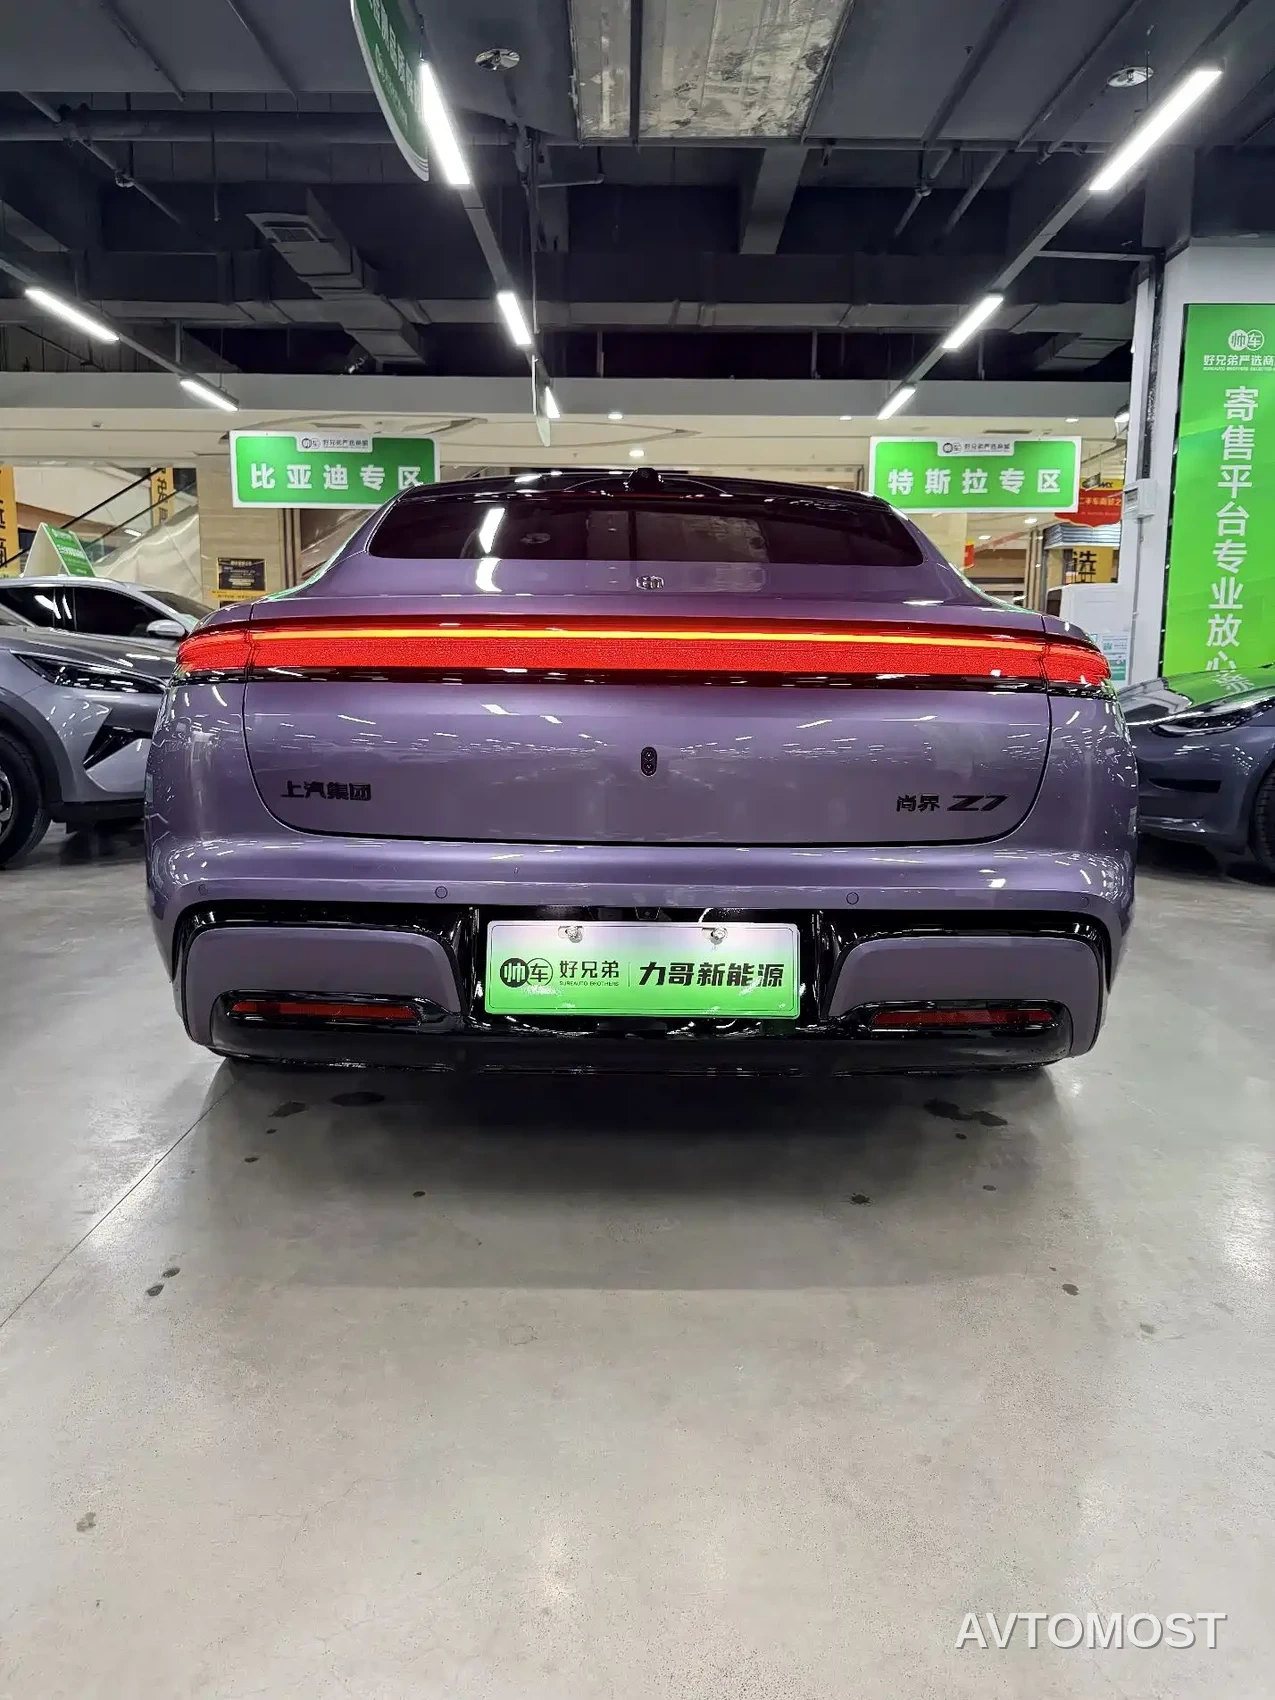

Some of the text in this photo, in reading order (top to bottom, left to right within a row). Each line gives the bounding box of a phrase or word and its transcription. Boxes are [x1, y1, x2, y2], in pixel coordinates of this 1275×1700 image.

[1228, 329, 1264, 351] 帅车
[1203, 354, 1275, 366] 好兄弟严选商
[250, 462, 422, 490] 比亚迪专区
[887, 468, 1061, 495] 特斯拉专区
[280, 780, 372, 801] 上汽集团
[896, 794, 1009, 812] 尚界 Z7
[500, 957, 784, 988] 帅车 好兄弟 力哥新能源
